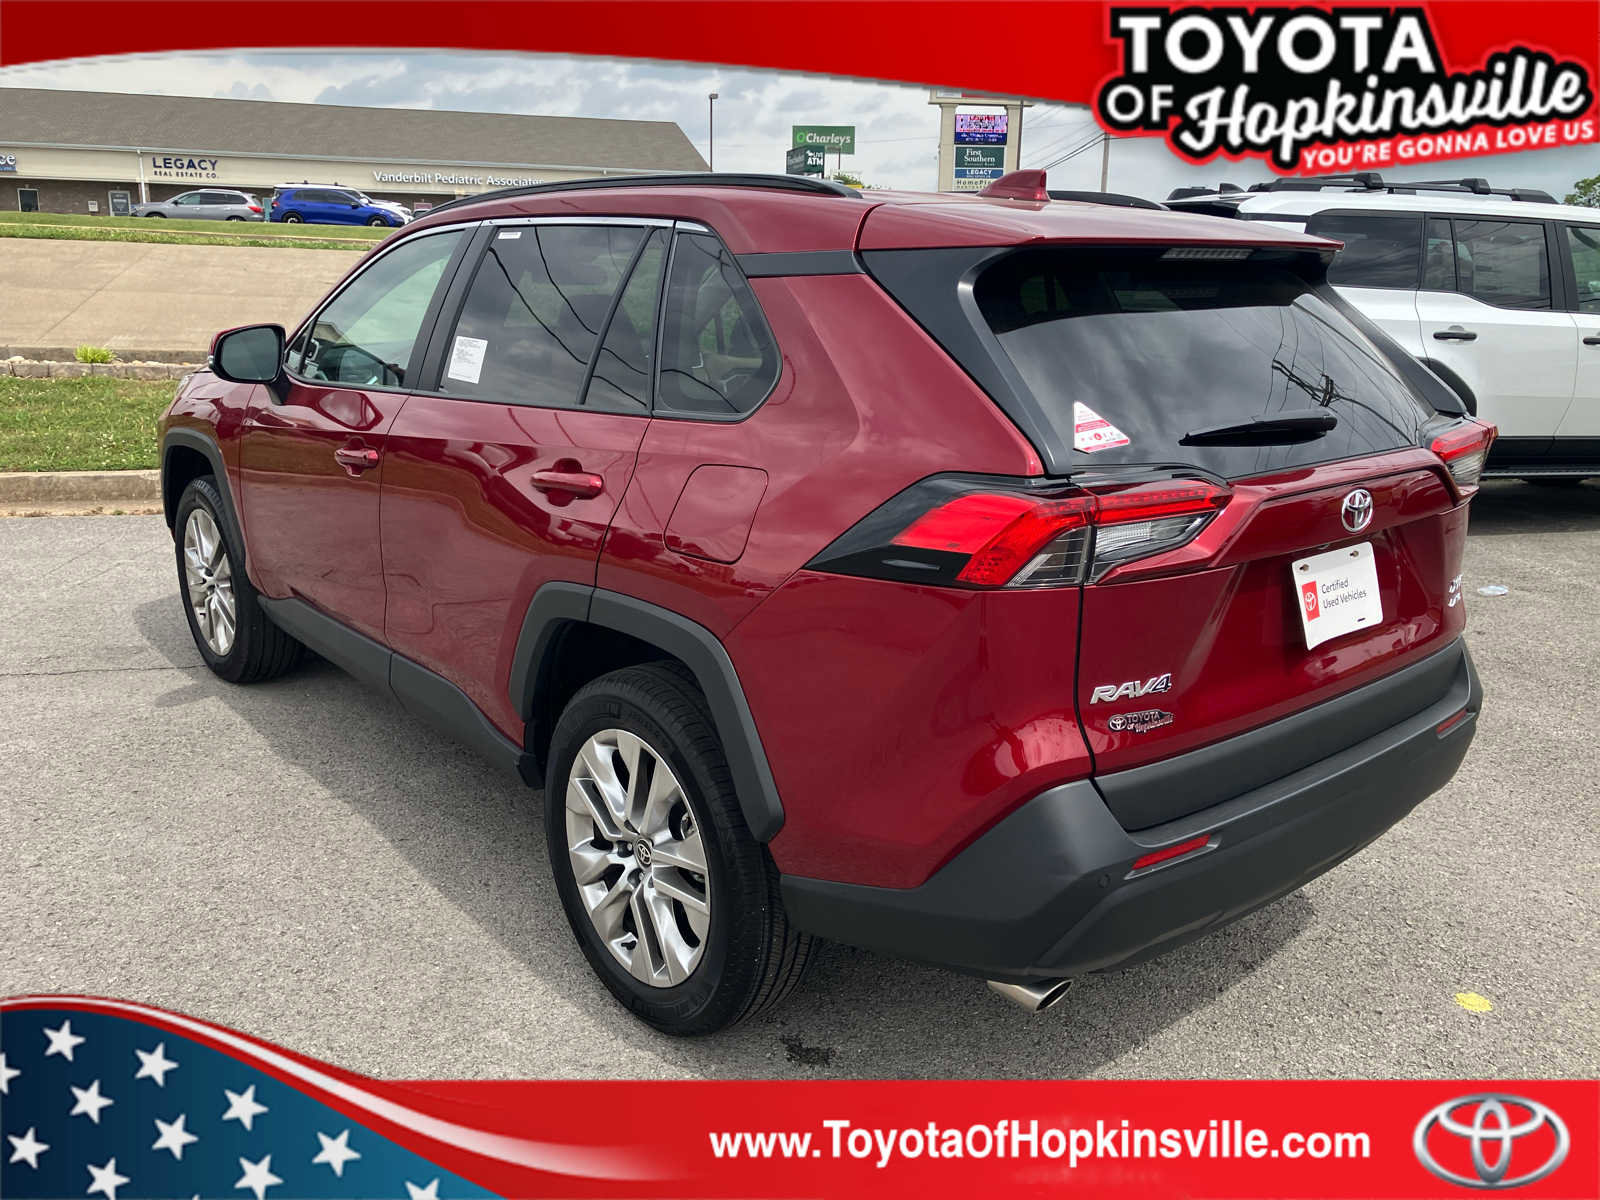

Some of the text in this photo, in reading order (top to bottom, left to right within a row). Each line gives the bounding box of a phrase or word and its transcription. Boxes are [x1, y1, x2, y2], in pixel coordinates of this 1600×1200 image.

[152, 157, 218, 171] LEGACY
[964, 155, 996, 163] Southern
[373, 171, 432, 183] Vanderbilt
[435, 173, 482, 185] Pediatric
[1321, 578, 1349, 594] Certified
[1323, 589, 1367, 609] Used Vehicles
[1090, 673, 1172, 705] RAV4
[1127, 711, 1160, 723] TOYOTA
